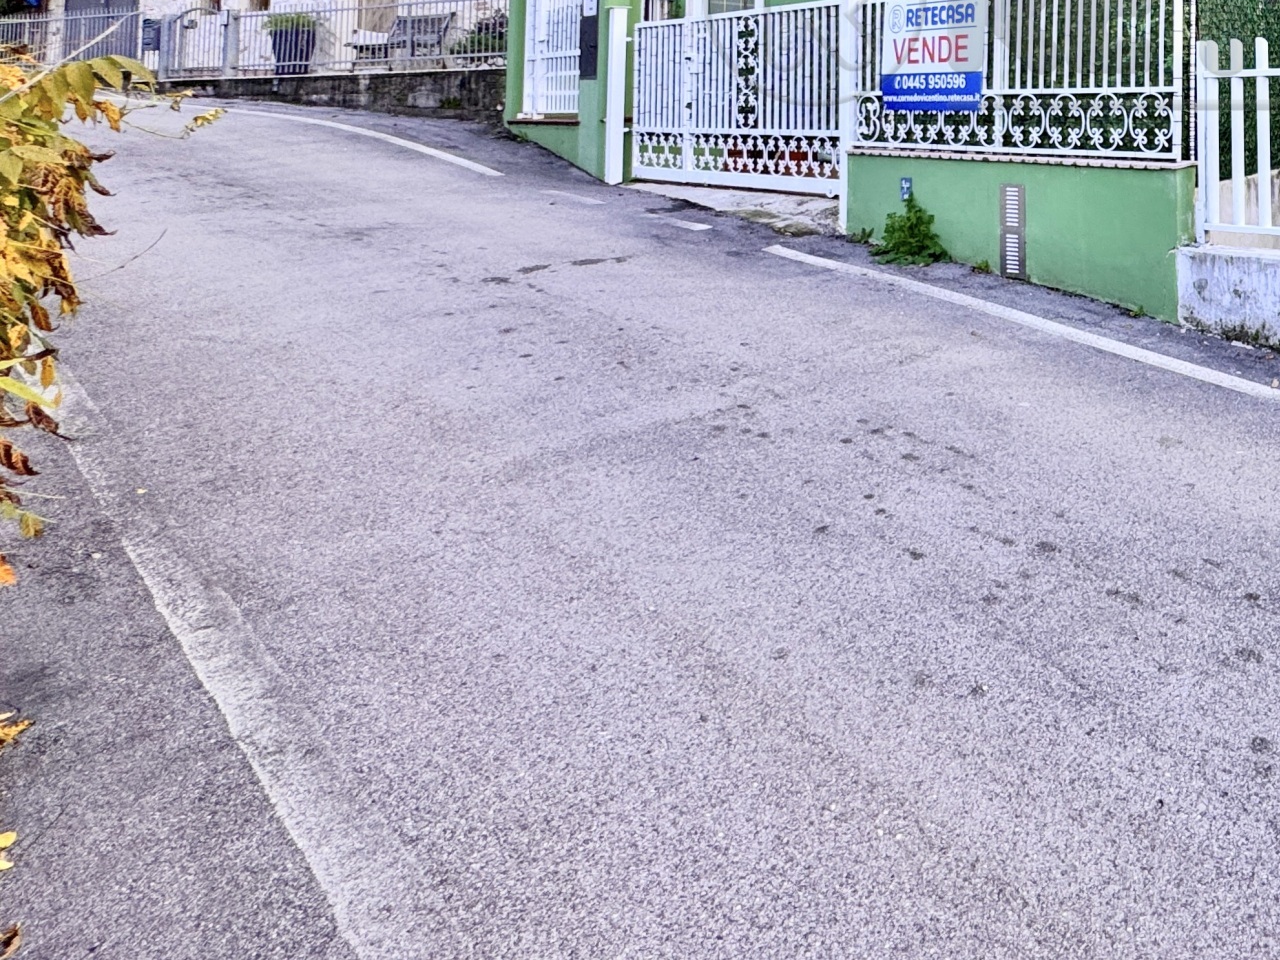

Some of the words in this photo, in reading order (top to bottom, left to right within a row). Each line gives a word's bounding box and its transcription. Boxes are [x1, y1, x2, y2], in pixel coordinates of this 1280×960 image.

[905, 3, 976, 28] RETECASA
[893, 34, 969, 65] VENDE
[901, 74, 926, 90] 0445
[928, 73, 967, 89] 950596
